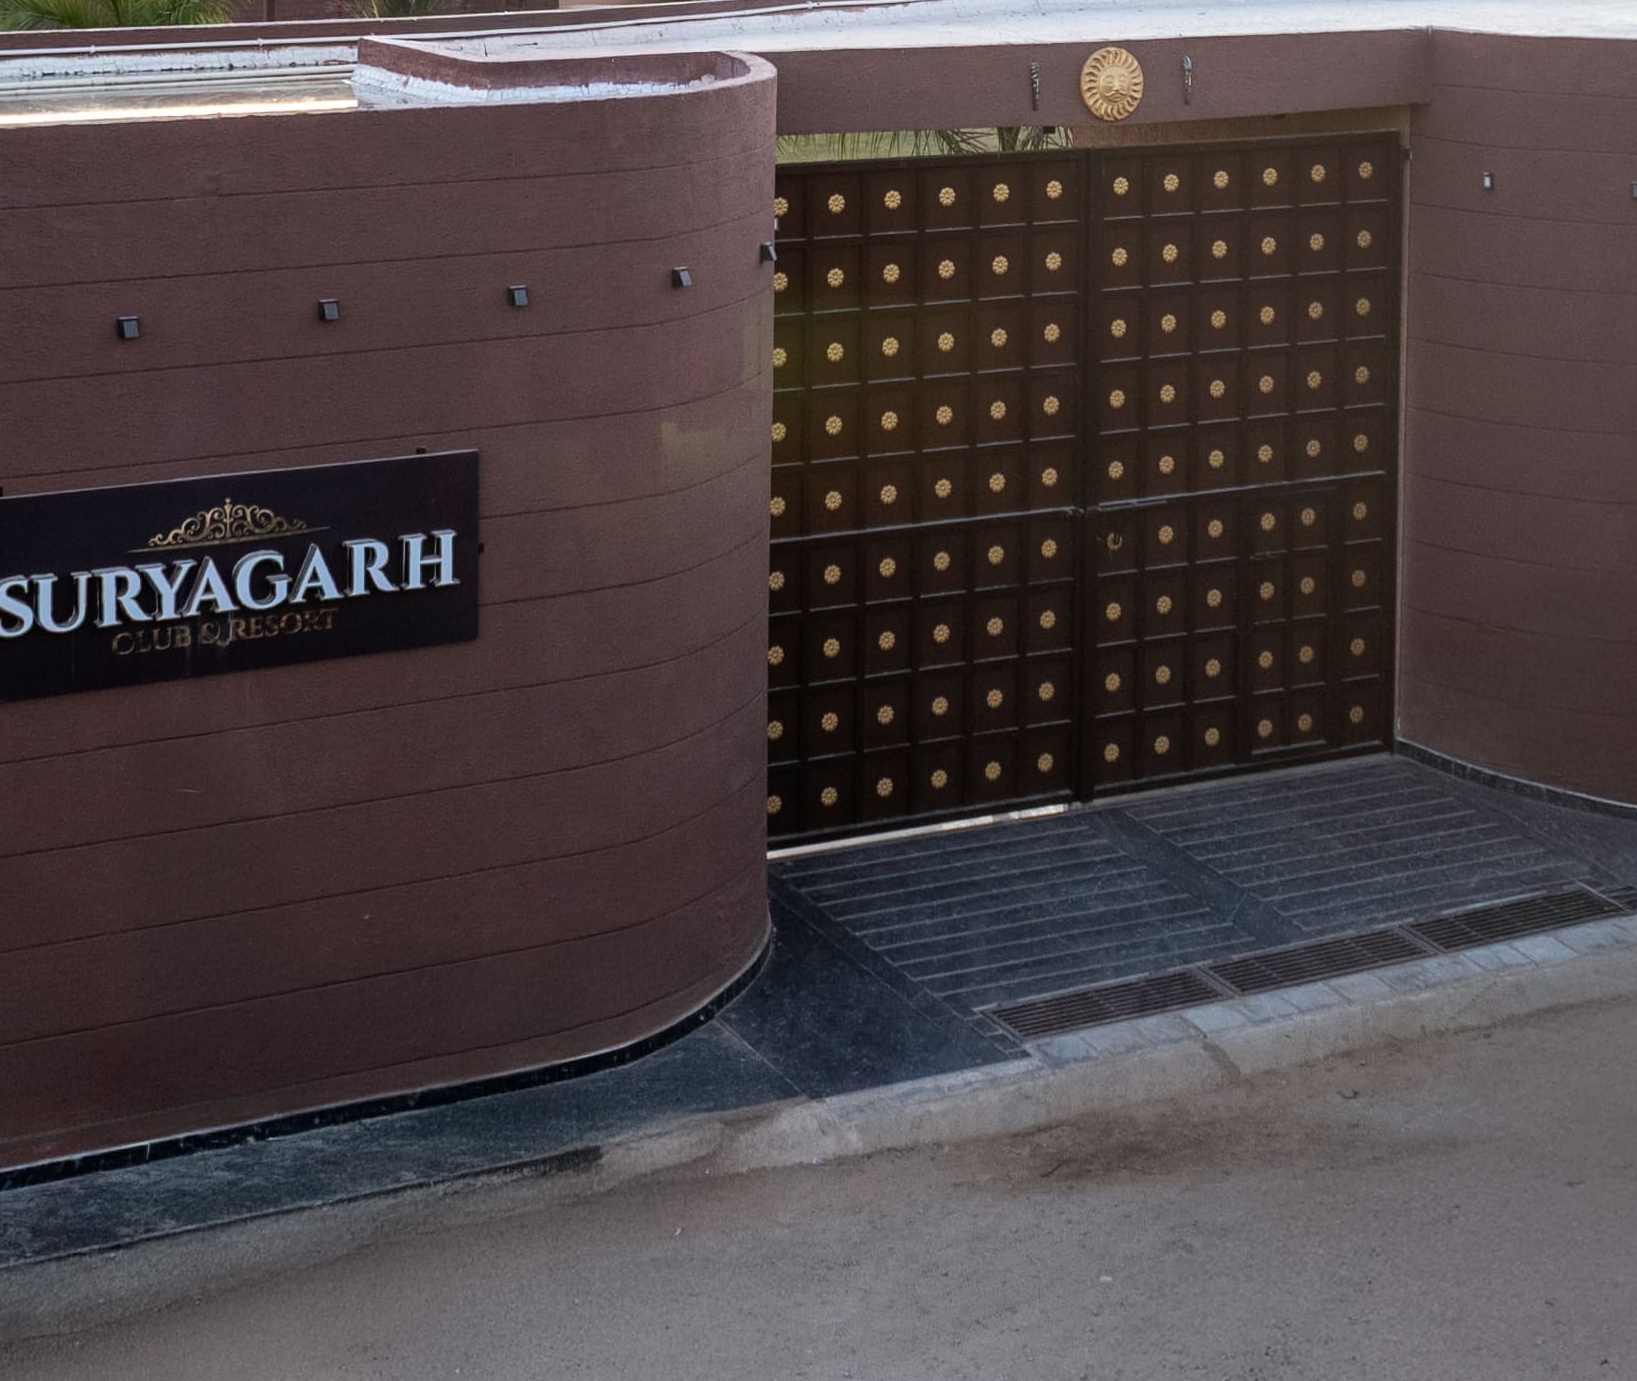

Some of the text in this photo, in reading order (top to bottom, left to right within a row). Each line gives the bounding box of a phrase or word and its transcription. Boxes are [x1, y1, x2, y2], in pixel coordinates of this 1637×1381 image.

[112, 607, 339, 656] CLUB & RESORT
